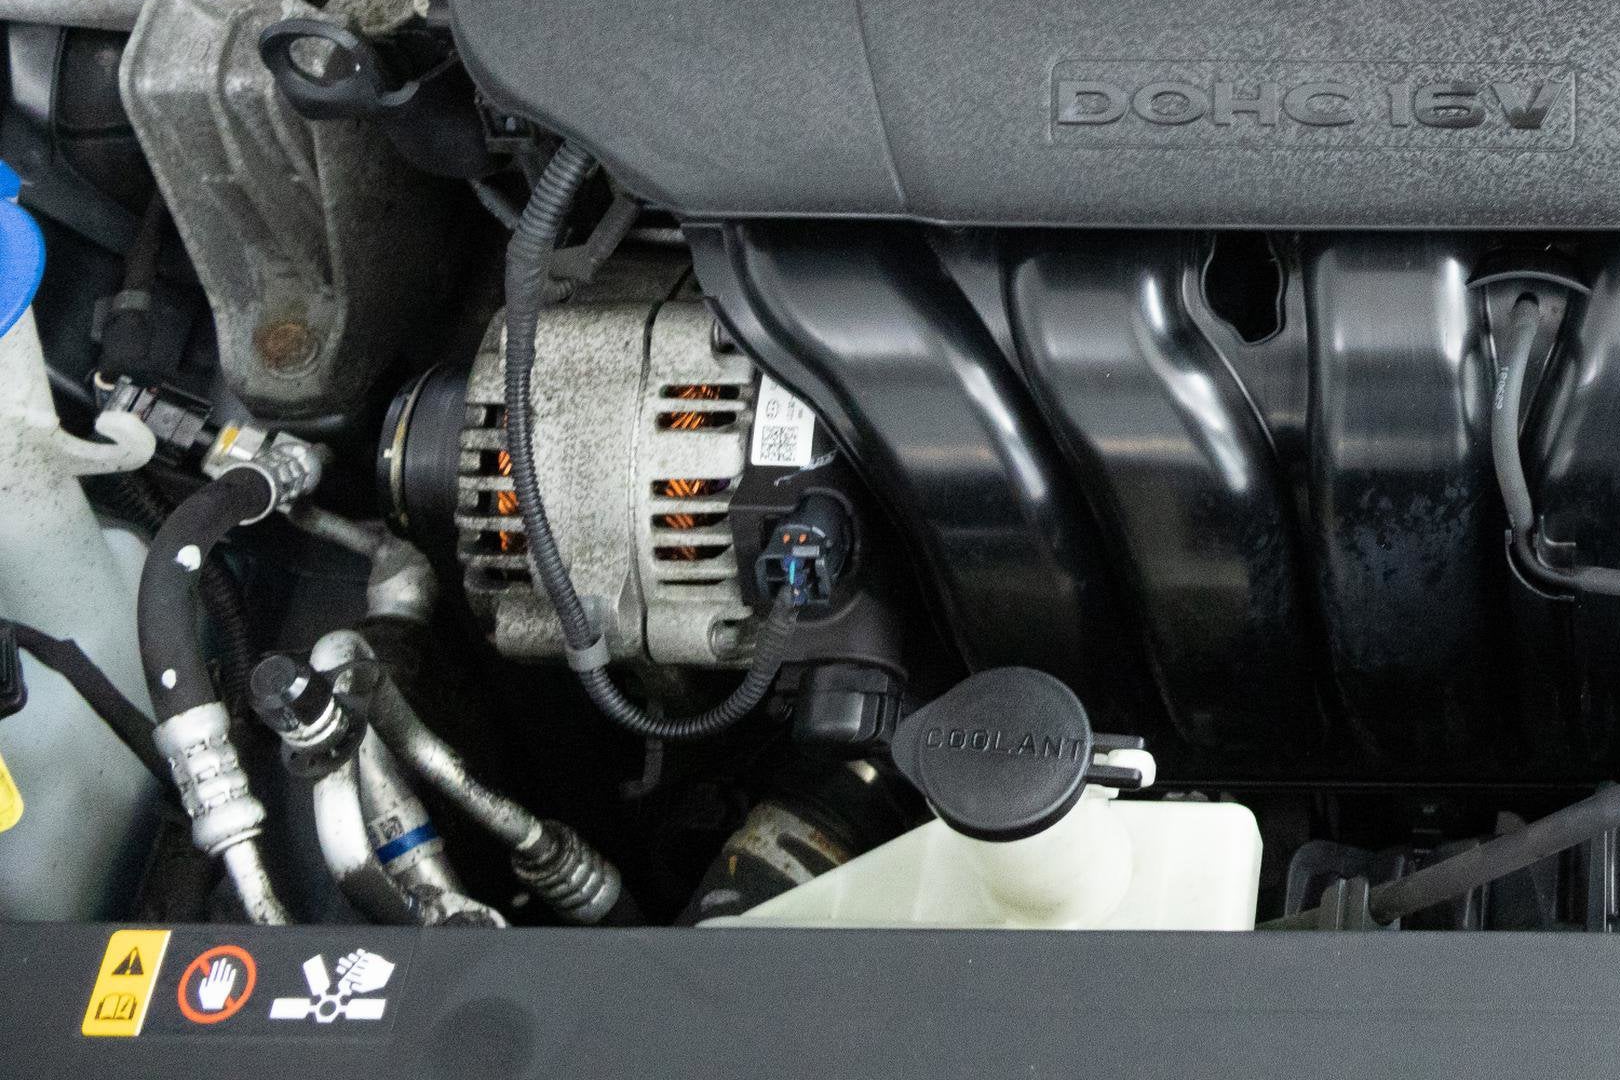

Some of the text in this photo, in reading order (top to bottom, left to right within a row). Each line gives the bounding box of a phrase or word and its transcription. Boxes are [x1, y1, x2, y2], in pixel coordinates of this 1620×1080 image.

[1056, 80, 1563, 130] DOHC 16V
[926, 727, 1086, 762] COOLANT
